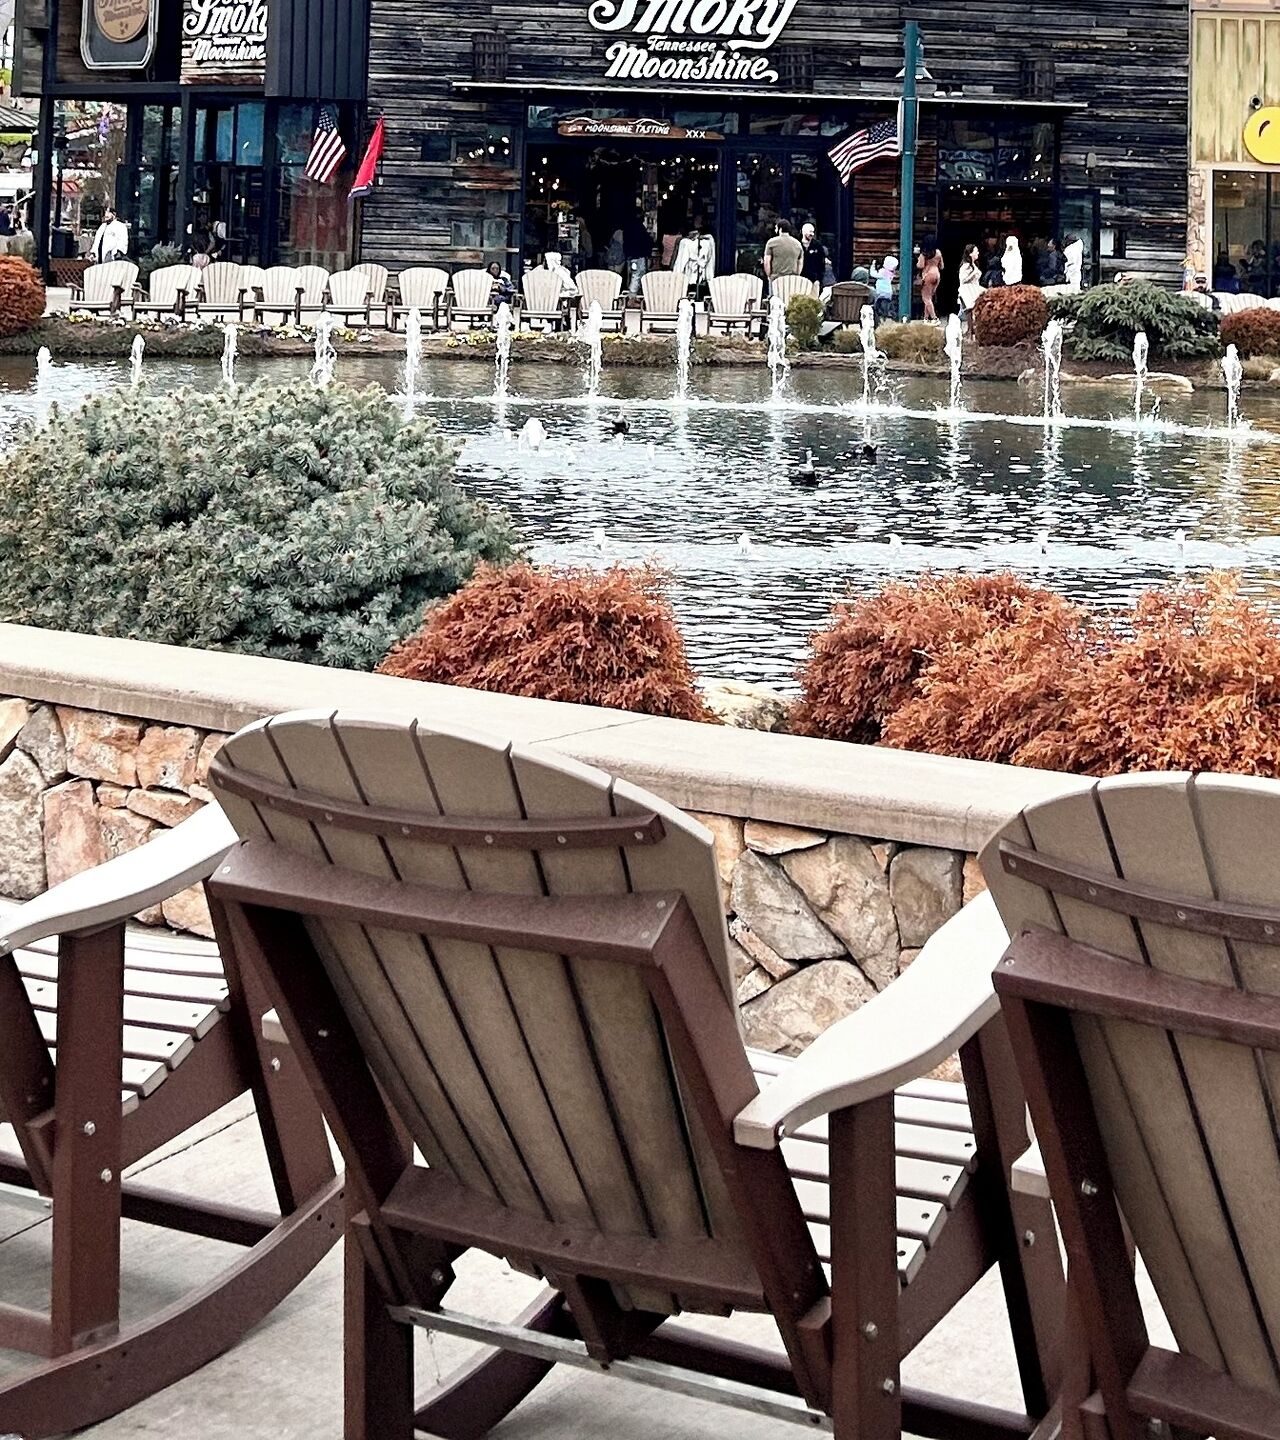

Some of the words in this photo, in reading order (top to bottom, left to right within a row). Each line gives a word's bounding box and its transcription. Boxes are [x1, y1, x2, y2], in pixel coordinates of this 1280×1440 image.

[647, 35, 717, 52] Tennessee
[605, 43, 778, 83] Moonshine
[584, 124, 633, 135] MOONSHINE
[635, 124, 670, 135] TASTING
[685, 129, 707, 139] XXX
